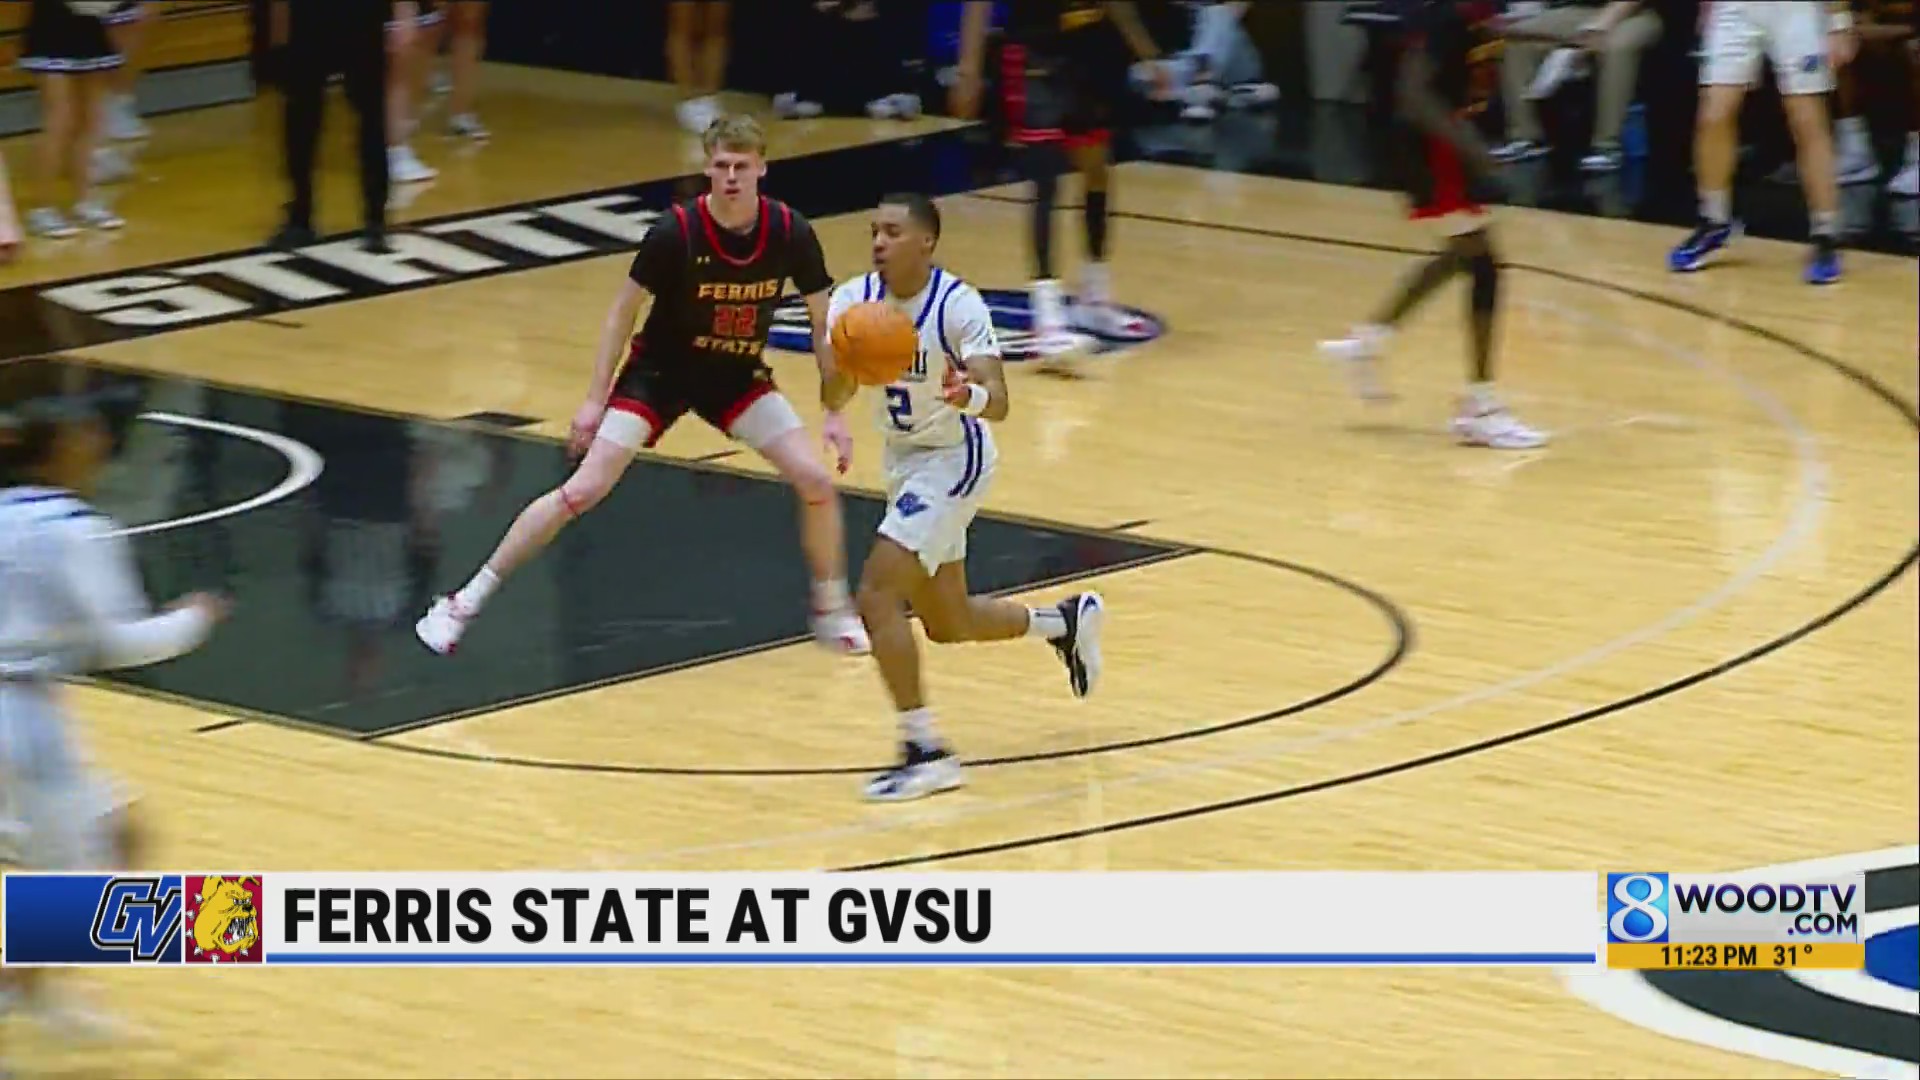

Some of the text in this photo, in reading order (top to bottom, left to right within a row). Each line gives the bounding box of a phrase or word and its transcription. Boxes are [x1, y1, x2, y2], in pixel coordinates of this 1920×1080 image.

[40, 194, 662, 326] STATE
[697, 279, 778, 301] FERRIS
[713, 304, 759, 337] 22
[693, 335, 762, 355] STATE
[885, 385, 914, 432] 2
